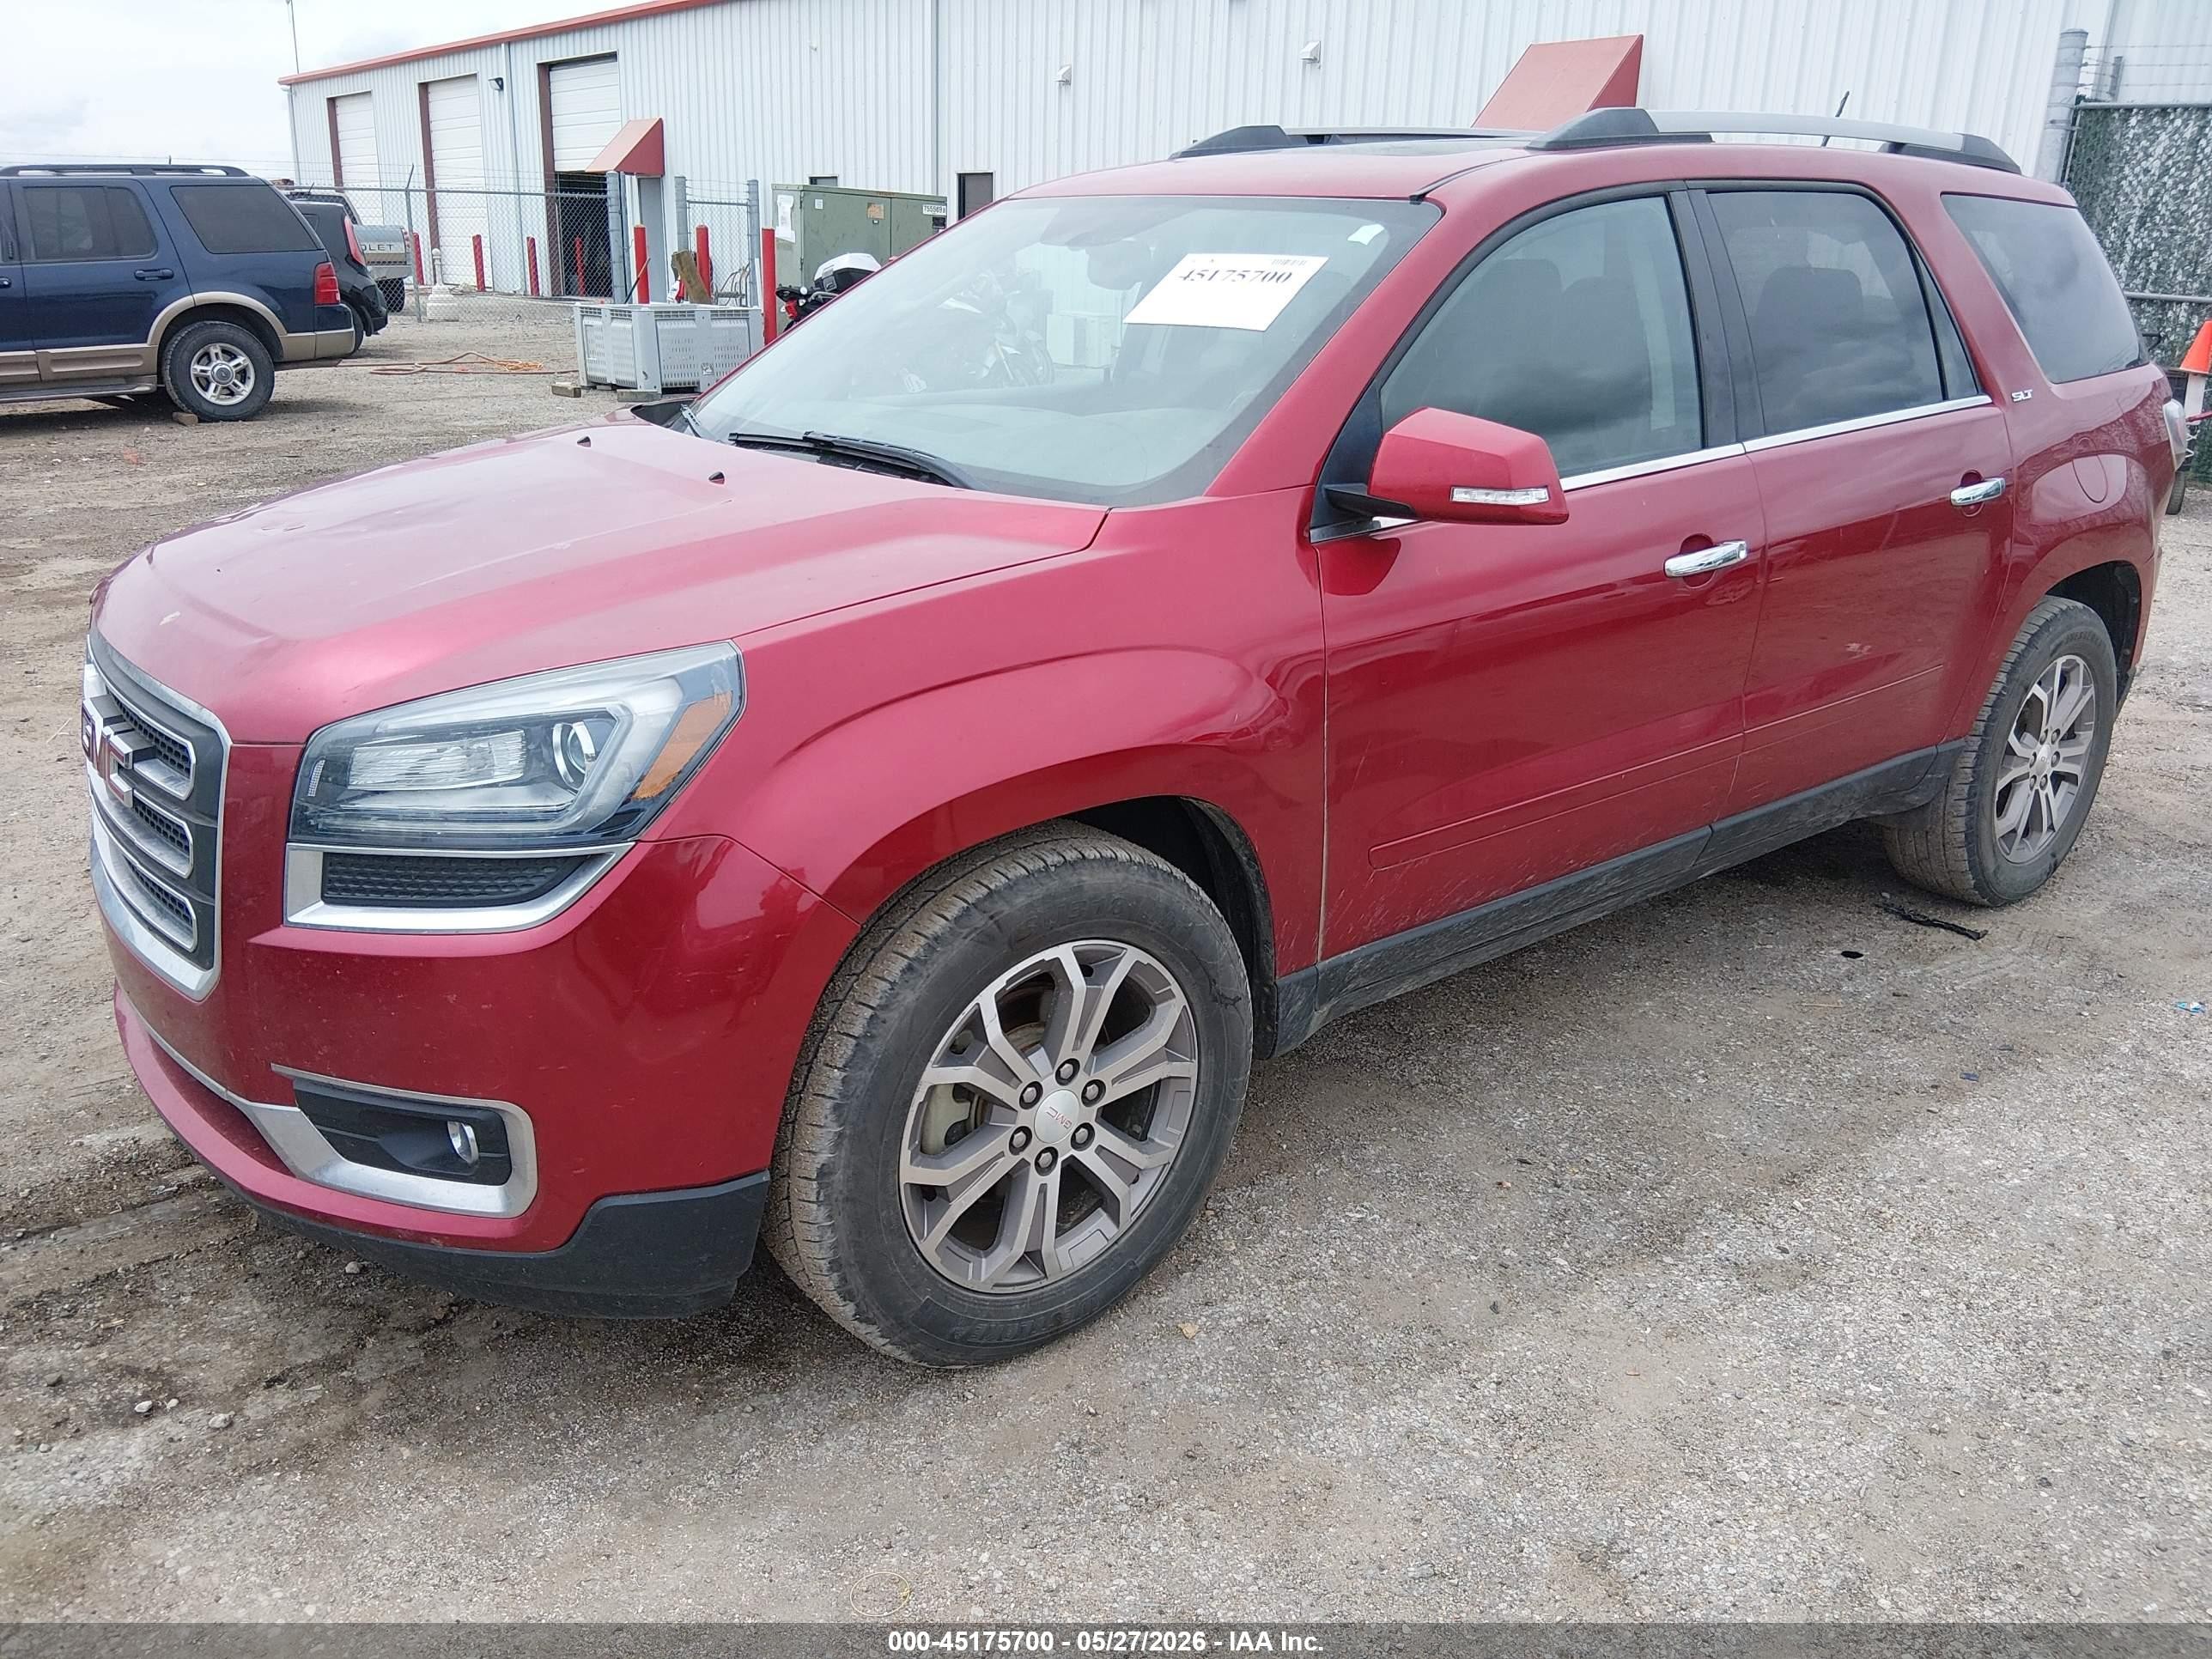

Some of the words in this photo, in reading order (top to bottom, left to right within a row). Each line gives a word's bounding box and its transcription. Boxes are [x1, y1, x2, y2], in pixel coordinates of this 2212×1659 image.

[1177, 268, 1293, 283] 45175700
[2011, 388, 2033, 402] SLT
[82, 697, 133, 808] GMC
[1045, 1105, 1073, 1130] GMC
